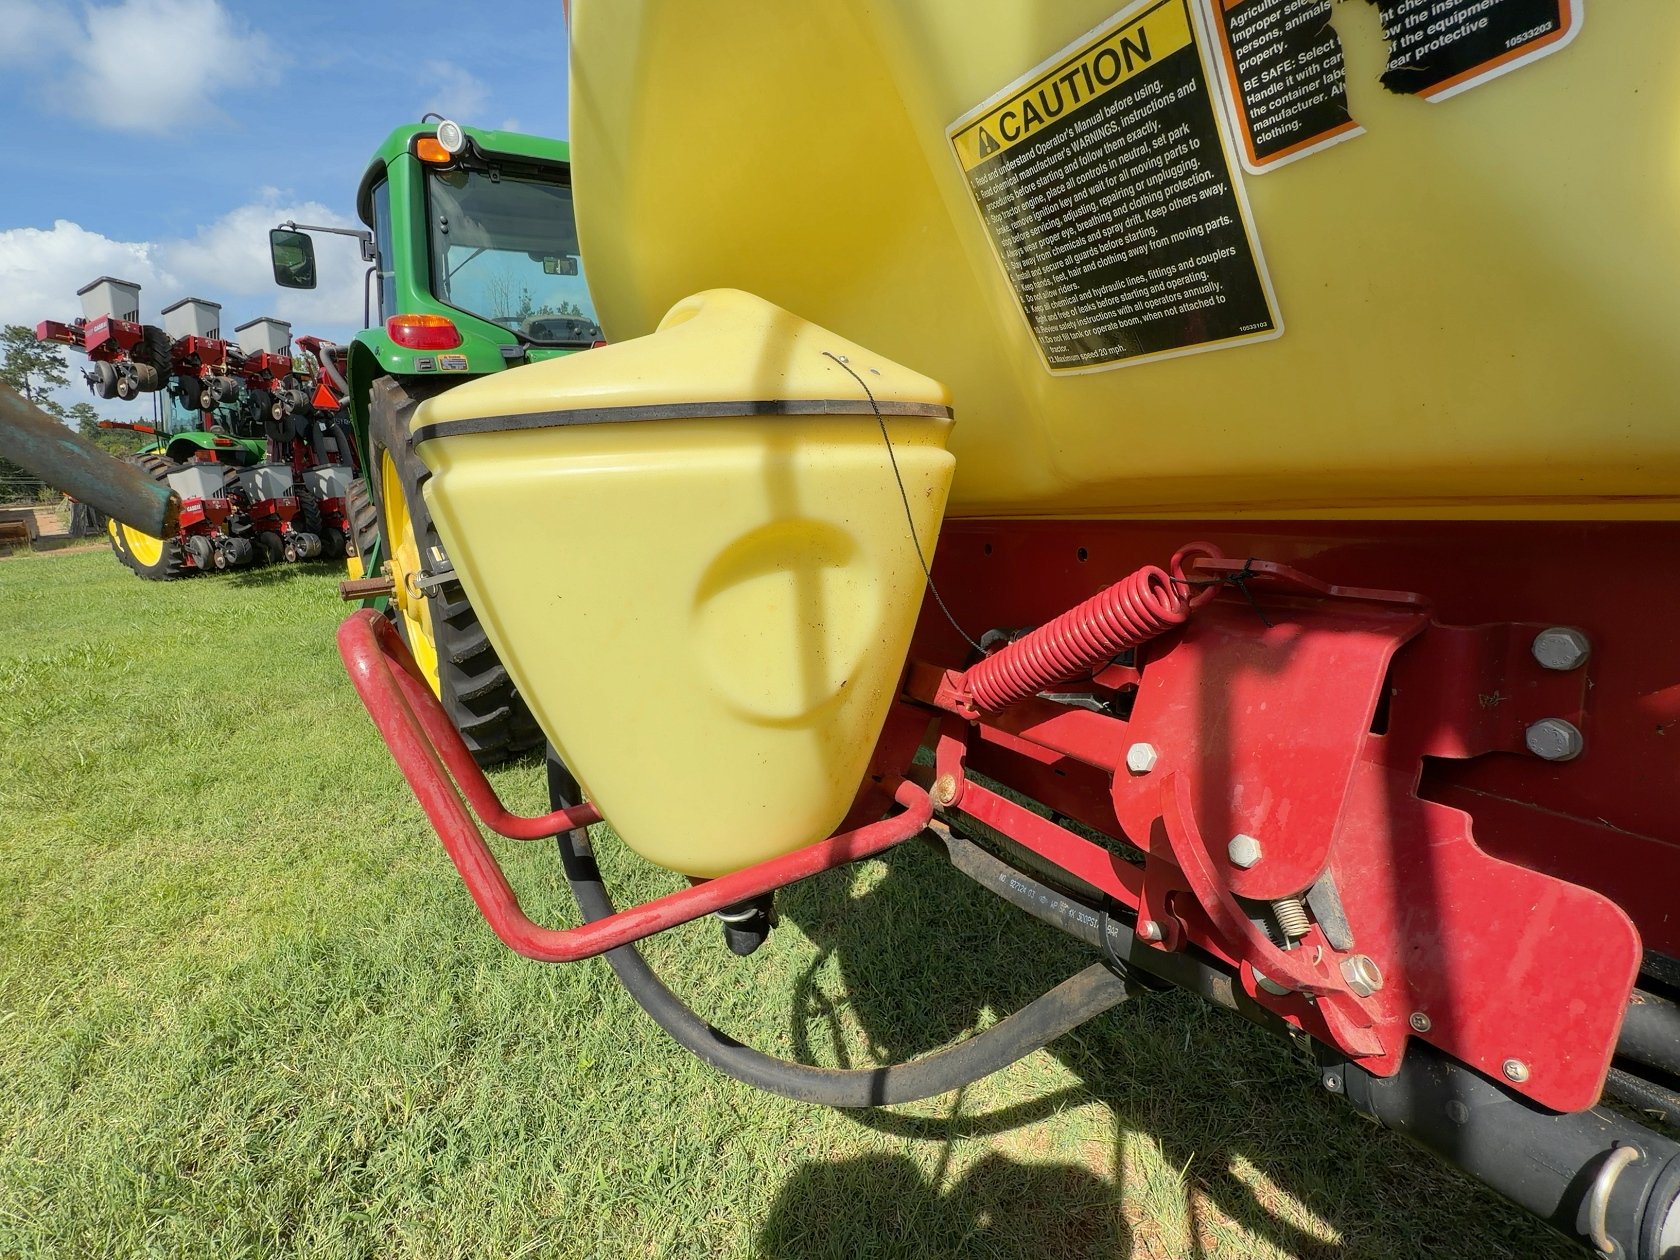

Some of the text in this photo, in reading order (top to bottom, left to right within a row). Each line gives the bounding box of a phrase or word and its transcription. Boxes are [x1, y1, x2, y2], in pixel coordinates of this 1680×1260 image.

[1232, 9, 1281, 43] Improper
[1400, 30, 1424, 49] the
[1404, 10, 1428, 28] the
[1415, 16, 1489, 60] protective
[1504, 20, 1552, 48] 10533203
[1236, 27, 1283, 60] persons,
[1239, 41, 1288, 74] property.
[1244, 38, 1335, 92] BE SAFE: Select
[999, 26, 1152, 142] CAUTION
[1246, 82, 1284, 106] Handle
[1286, 75, 1294, 86] it
[1296, 63, 1320, 82] with
[1250, 106, 1267, 119] the
[1269, 80, 1320, 110] container
[988, 167, 998, 180] and
[999, 147, 1035, 174] understand
[1035, 127, 1074, 155] Operator's
[1074, 108, 1104, 133] Manual
[1104, 94, 1133, 117] before
[1134, 80, 1163, 101] using.
[1254, 92, 1328, 132] manufacturer.
[1256, 120, 1302, 144] clothing.
[993, 172, 1019, 193] chemical
[1019, 147, 1071, 180] manufacturer's
[1071, 119, 1121, 152] WARNINGS,
[1120, 91, 1175, 127] instructions
[1177, 77, 1196, 98] and
[1002, 204, 1021, 218] tractor
[1021, 194, 1046, 210] engine,
[1046, 183, 1065, 200] place
[1066, 176, 1075, 189] all
[1076, 163, 1108, 184] controls
[1108, 158, 1117, 169] in
[1119, 141, 1151, 164] neutral,
[1152, 133, 1167, 148] set
[1168, 121, 1190, 143] park
[1014, 182, 1036, 198] before
[1036, 168, 1064, 187] starting
[1064, 158, 1079, 173] and
[1078, 148, 1103, 166] follow
[1104, 137, 1125, 154] them
[1126, 120, 1161, 143] exactly.
[1011, 214, 1033, 229] remove
[1033, 202, 1059, 220] ignition
[1059, 196, 1074, 208] key
[1073, 187, 1088, 202] and
[1089, 180, 1105, 195] wait
[1105, 175, 1118, 187] for
[1119, 168, 1129, 181] all
[1130, 155, 1163, 176] moving
[1164, 143, 1188, 163] parts
[1189, 137, 1200, 149] to
[1011, 230, 1030, 242] before
[1030, 218, 1063, 235] servicing,
[1063, 202, 1099, 222] adjusting,
[1099, 185, 1135, 206] repairing
[1136, 180, 1146, 191] or
[1146, 158, 1200, 186] unplugging.
[1024, 241, 1038, 252] wear
[1039, 232, 1061, 248] proper
[1061, 226, 1076, 238] eye,
[1076, 211, 1112, 231] breathing
[1113, 202, 1128, 216] and
[1129, 190, 1164, 210] clothing
[1164, 170, 1214, 198] protection.
[1035, 250, 1052, 261] from
[1052, 236, 1086, 255] chemicals
[1087, 229, 1101, 242] and
[1102, 222, 1124, 237] spray
[1124, 213, 1144, 227] drift.
[1144, 205, 1168, 220] Keep
[1168, 193, 1197, 211] others
[1199, 182, 1227, 199] away.
[1031, 226, 1158, 276] and secure all guards before starting.
[1052, 272, 1068, 282] feet,
[1068, 266, 1082, 277] hair
[1083, 260, 1096, 272] and
[1097, 251, 1128, 267] clothing
[1128, 244, 1149, 257] away
[1149, 236, 1169, 249] from
[1171, 224, 1204, 242] moving
[1205, 216, 1233, 233] parts.
[1051, 293, 1078, 308] chemical
[1079, 289, 1092, 300] and
[1092, 280, 1126, 296] hydraulic
[1126, 274, 1148, 286] lines,
[1148, 264, 1176, 279] fittings
[1178, 256, 1194, 270] and
[1196, 246, 1236, 264] couplers
[1058, 283, 1080, 294] riders.
[1070, 306, 1078, 315] of
[1078, 302, 1096, 313] leaks
[1096, 296, 1119, 308] before
[1120, 287, 1149, 301] starting
[1150, 280, 1165, 292] and
[1166, 270, 1209, 288] operating.
[1059, 281, 1222, 330] safety instructions with all operators annually.
[1070, 329, 1083, 338] tank
[1092, 322, 1118, 334] operate
[1118, 317, 1142, 327] boom,
[1142, 311, 1163, 321] when
[1164, 306, 1177, 316] not
[1179, 295, 1215, 312] attached
[1216, 295, 1226, 303] to
[1080, 343, 1126, 360] speed 20 mph.
